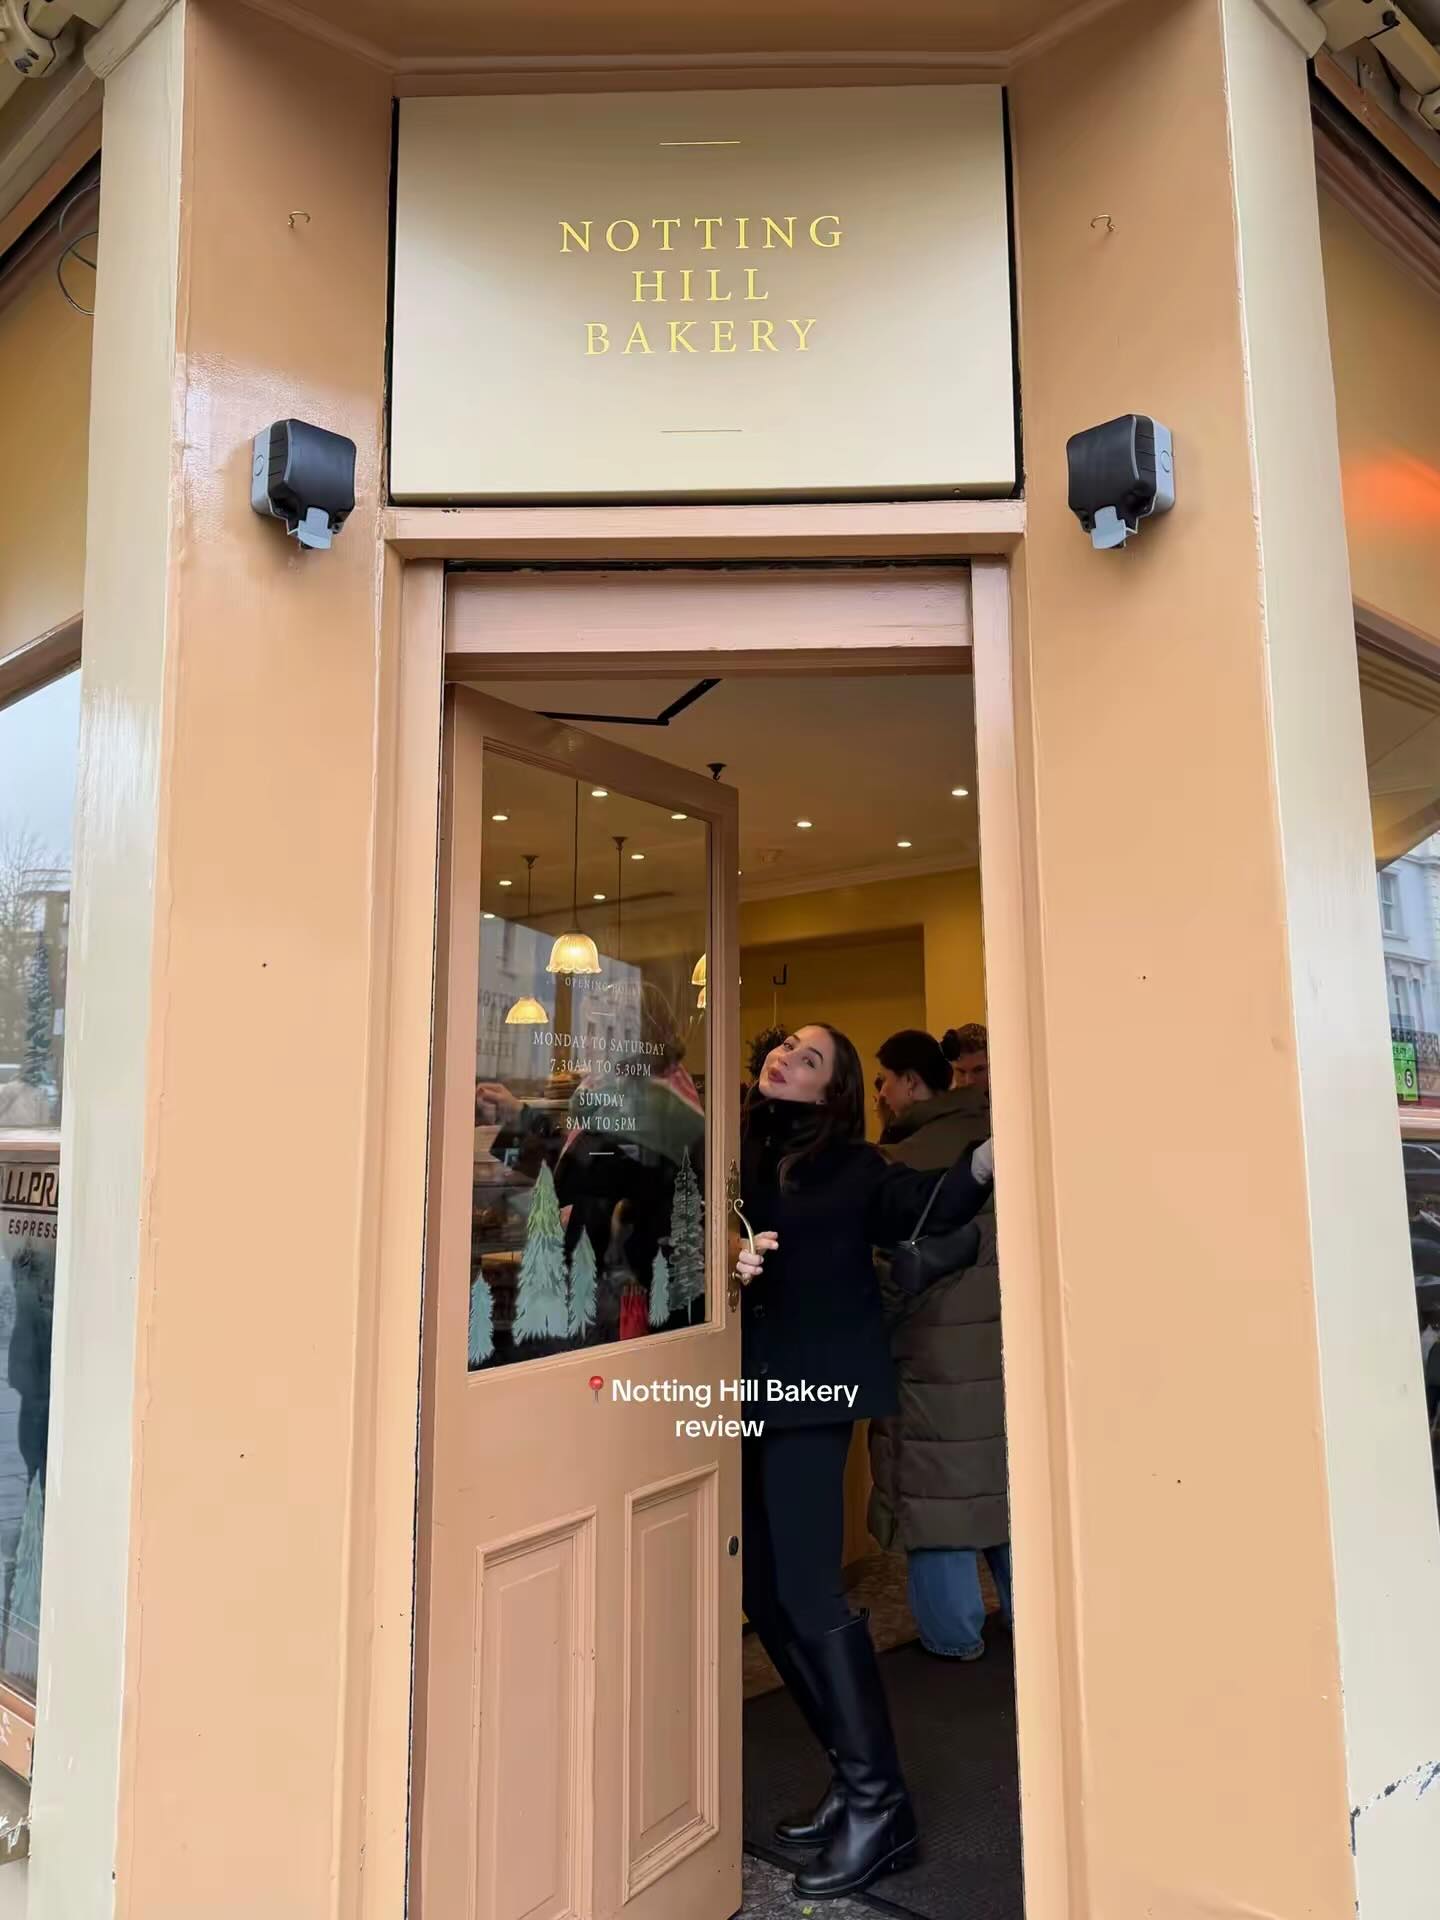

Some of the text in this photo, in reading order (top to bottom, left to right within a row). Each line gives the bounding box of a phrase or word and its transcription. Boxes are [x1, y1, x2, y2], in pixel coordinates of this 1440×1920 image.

[558, 215, 843, 253] NOTTING
[631, 268, 769, 302] HILL
[583, 318, 817, 355] BAKERY
[564, 976, 610, 992] OPENING
[533, 1031, 665, 1056] MONDAY TO SATURDAY
[550, 1058, 651, 1077] 7.30AM TO 5.30PM
[579, 1092, 625, 1107] SUNDAY
[566, 1116, 636, 1131] 8AM TO 5PM
[5, 1169, 58, 1207] LLPR
